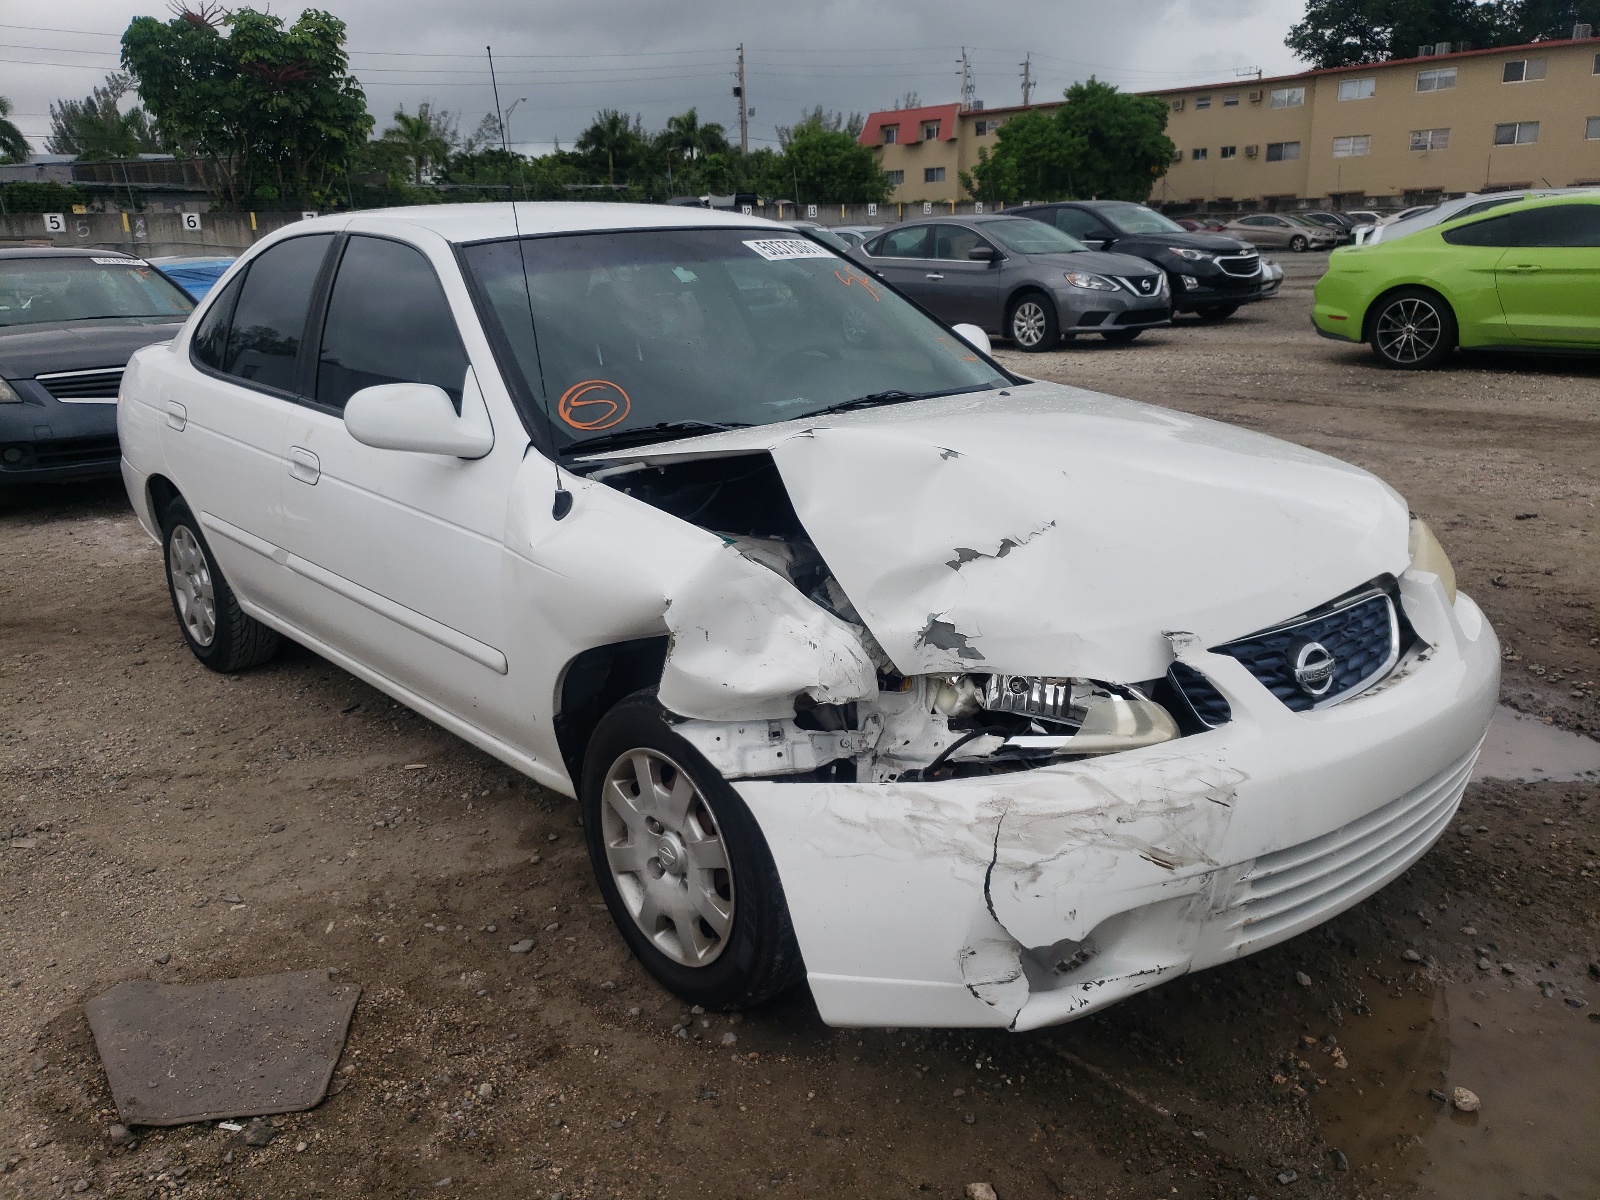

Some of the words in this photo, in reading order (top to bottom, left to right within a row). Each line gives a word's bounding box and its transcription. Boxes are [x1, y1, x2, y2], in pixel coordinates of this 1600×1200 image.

[809, 206, 817, 217] 13
[869, 205, 876, 215] 14
[924, 204, 931, 214] 15
[49, 215, 61, 230] 5
[76, 219, 90, 238] 5
[186, 214, 197, 229] 6
[564, 385, 618, 428] S
[1302, 660, 1335, 682] NISSAN
